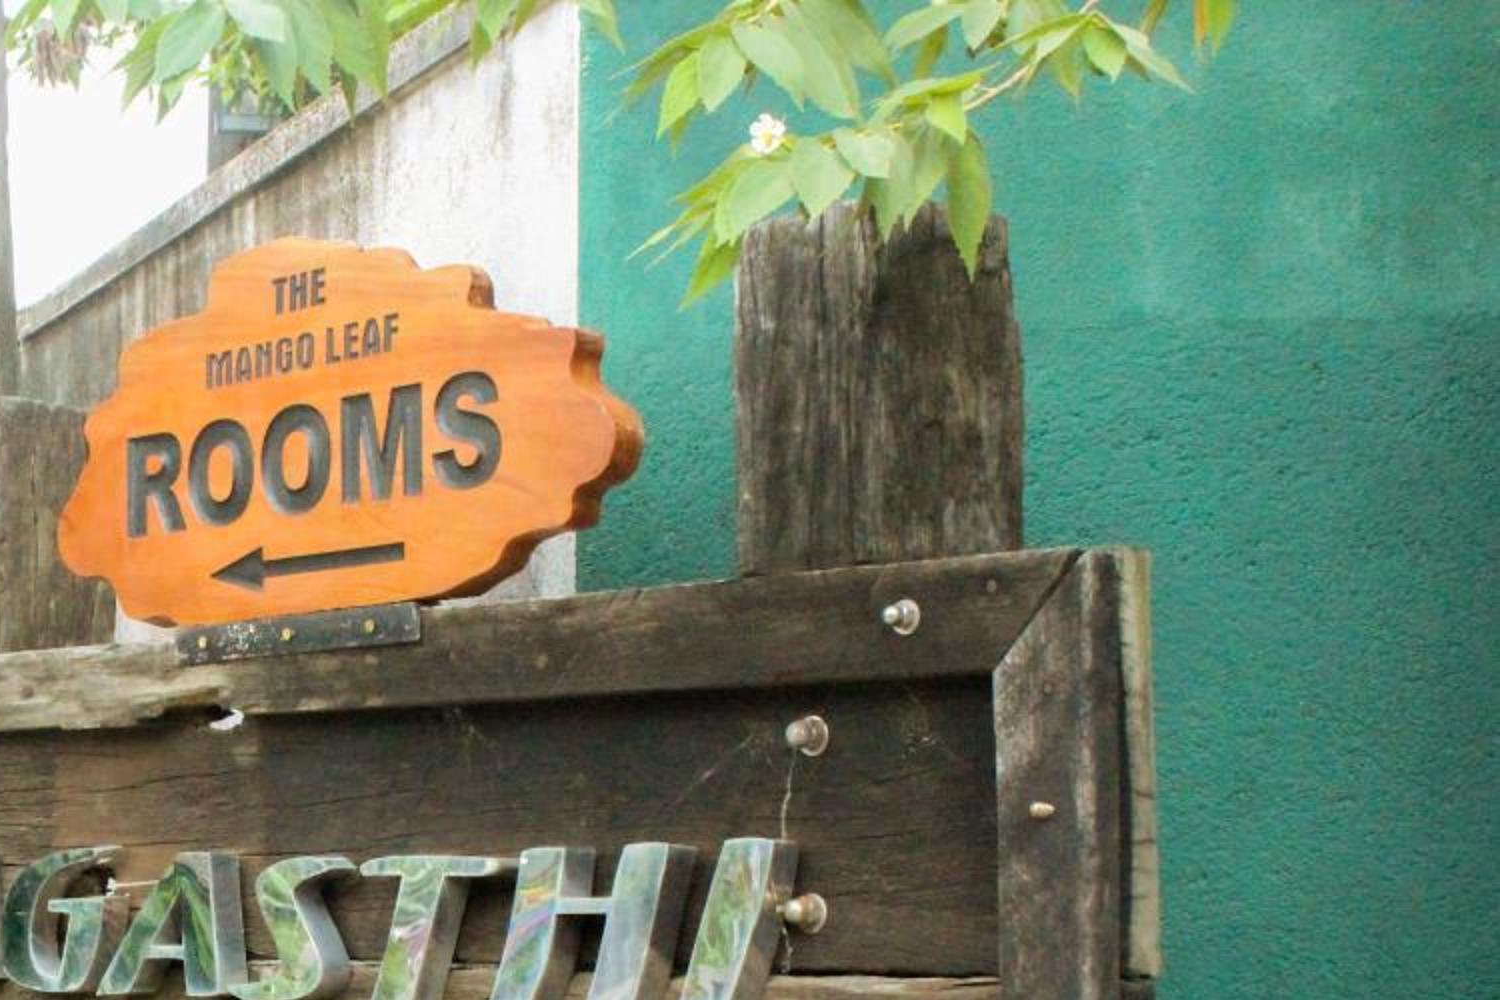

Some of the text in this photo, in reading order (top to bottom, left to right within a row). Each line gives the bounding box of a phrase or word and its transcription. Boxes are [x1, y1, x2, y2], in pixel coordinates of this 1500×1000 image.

[273, 267, 327, 315] THE
[205, 312, 400, 389] MANGO LEAF
[125, 370, 501, 538] ROOMS
